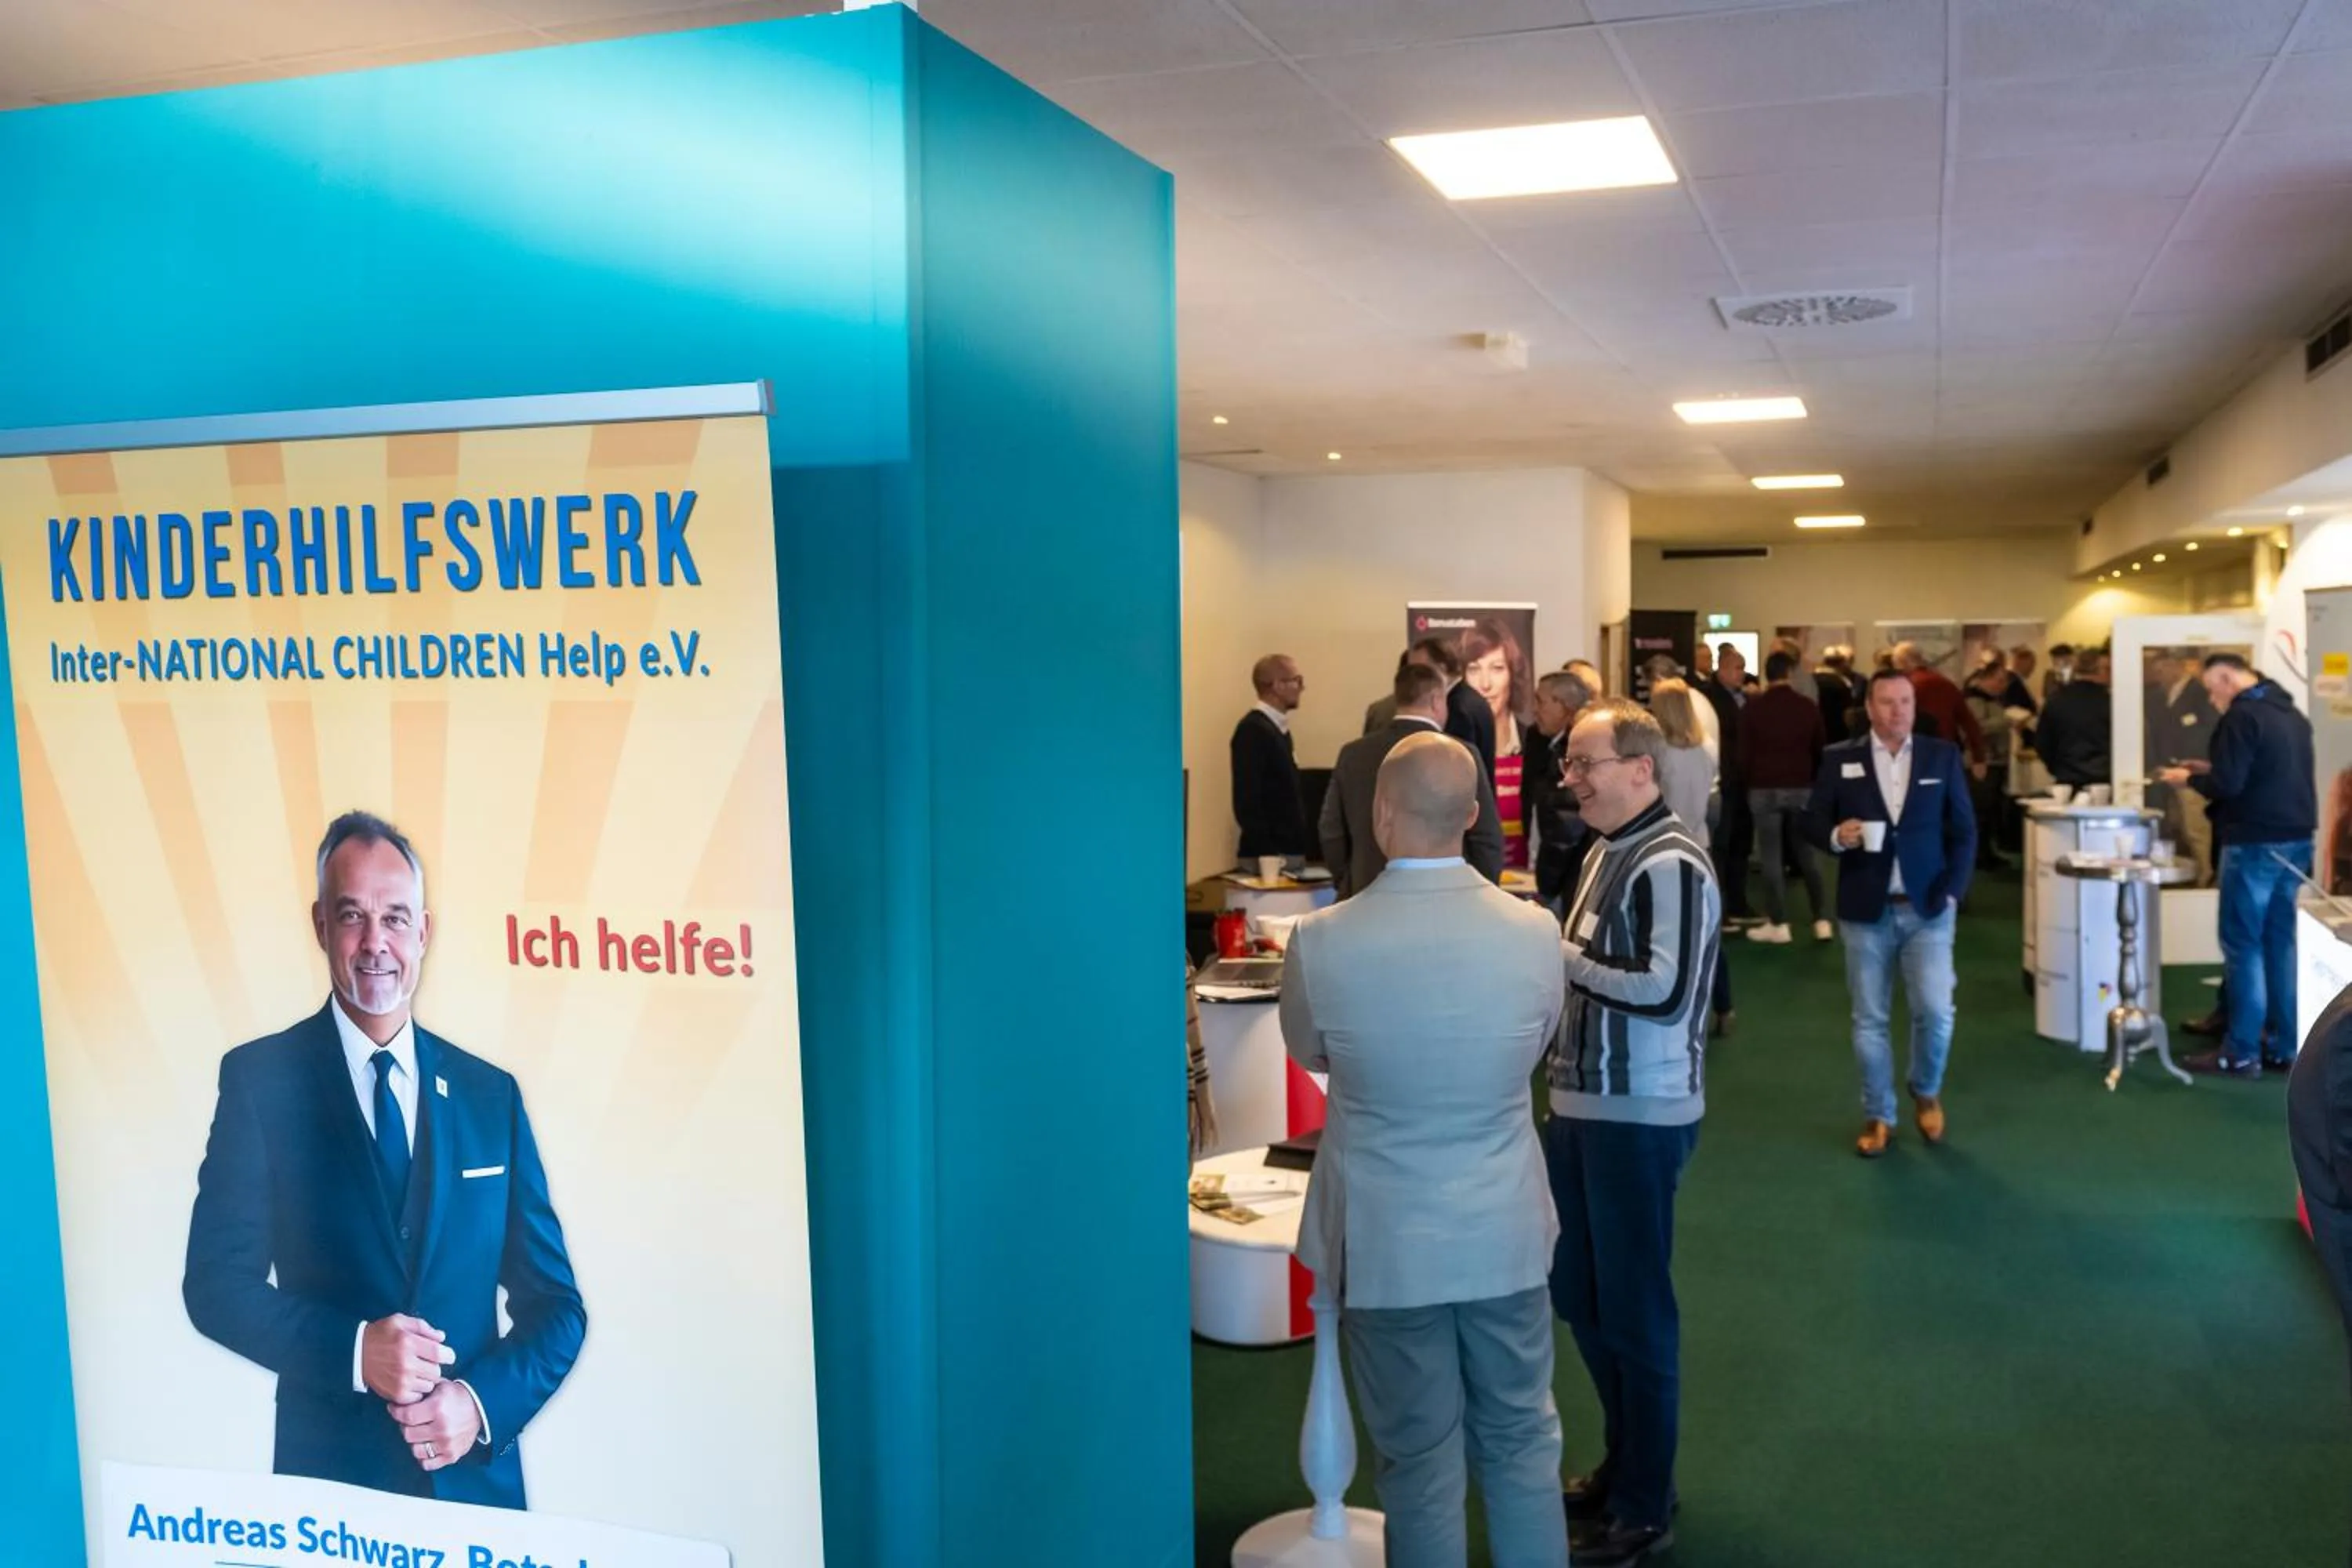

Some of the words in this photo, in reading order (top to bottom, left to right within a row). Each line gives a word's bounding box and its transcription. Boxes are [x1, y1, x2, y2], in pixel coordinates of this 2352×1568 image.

[47, 491, 702, 602] KINDERHILFSWERK
[50, 636, 325, 682] Inter-NATIONAL
[332, 633, 525, 679] CHILDREN
[539, 631, 626, 687] Help
[639, 630, 710, 677] e.V.
[506, 914, 580, 969] Ich
[597, 916, 754, 978] helfe!
[127, 1503, 288, 1551] Andreas
